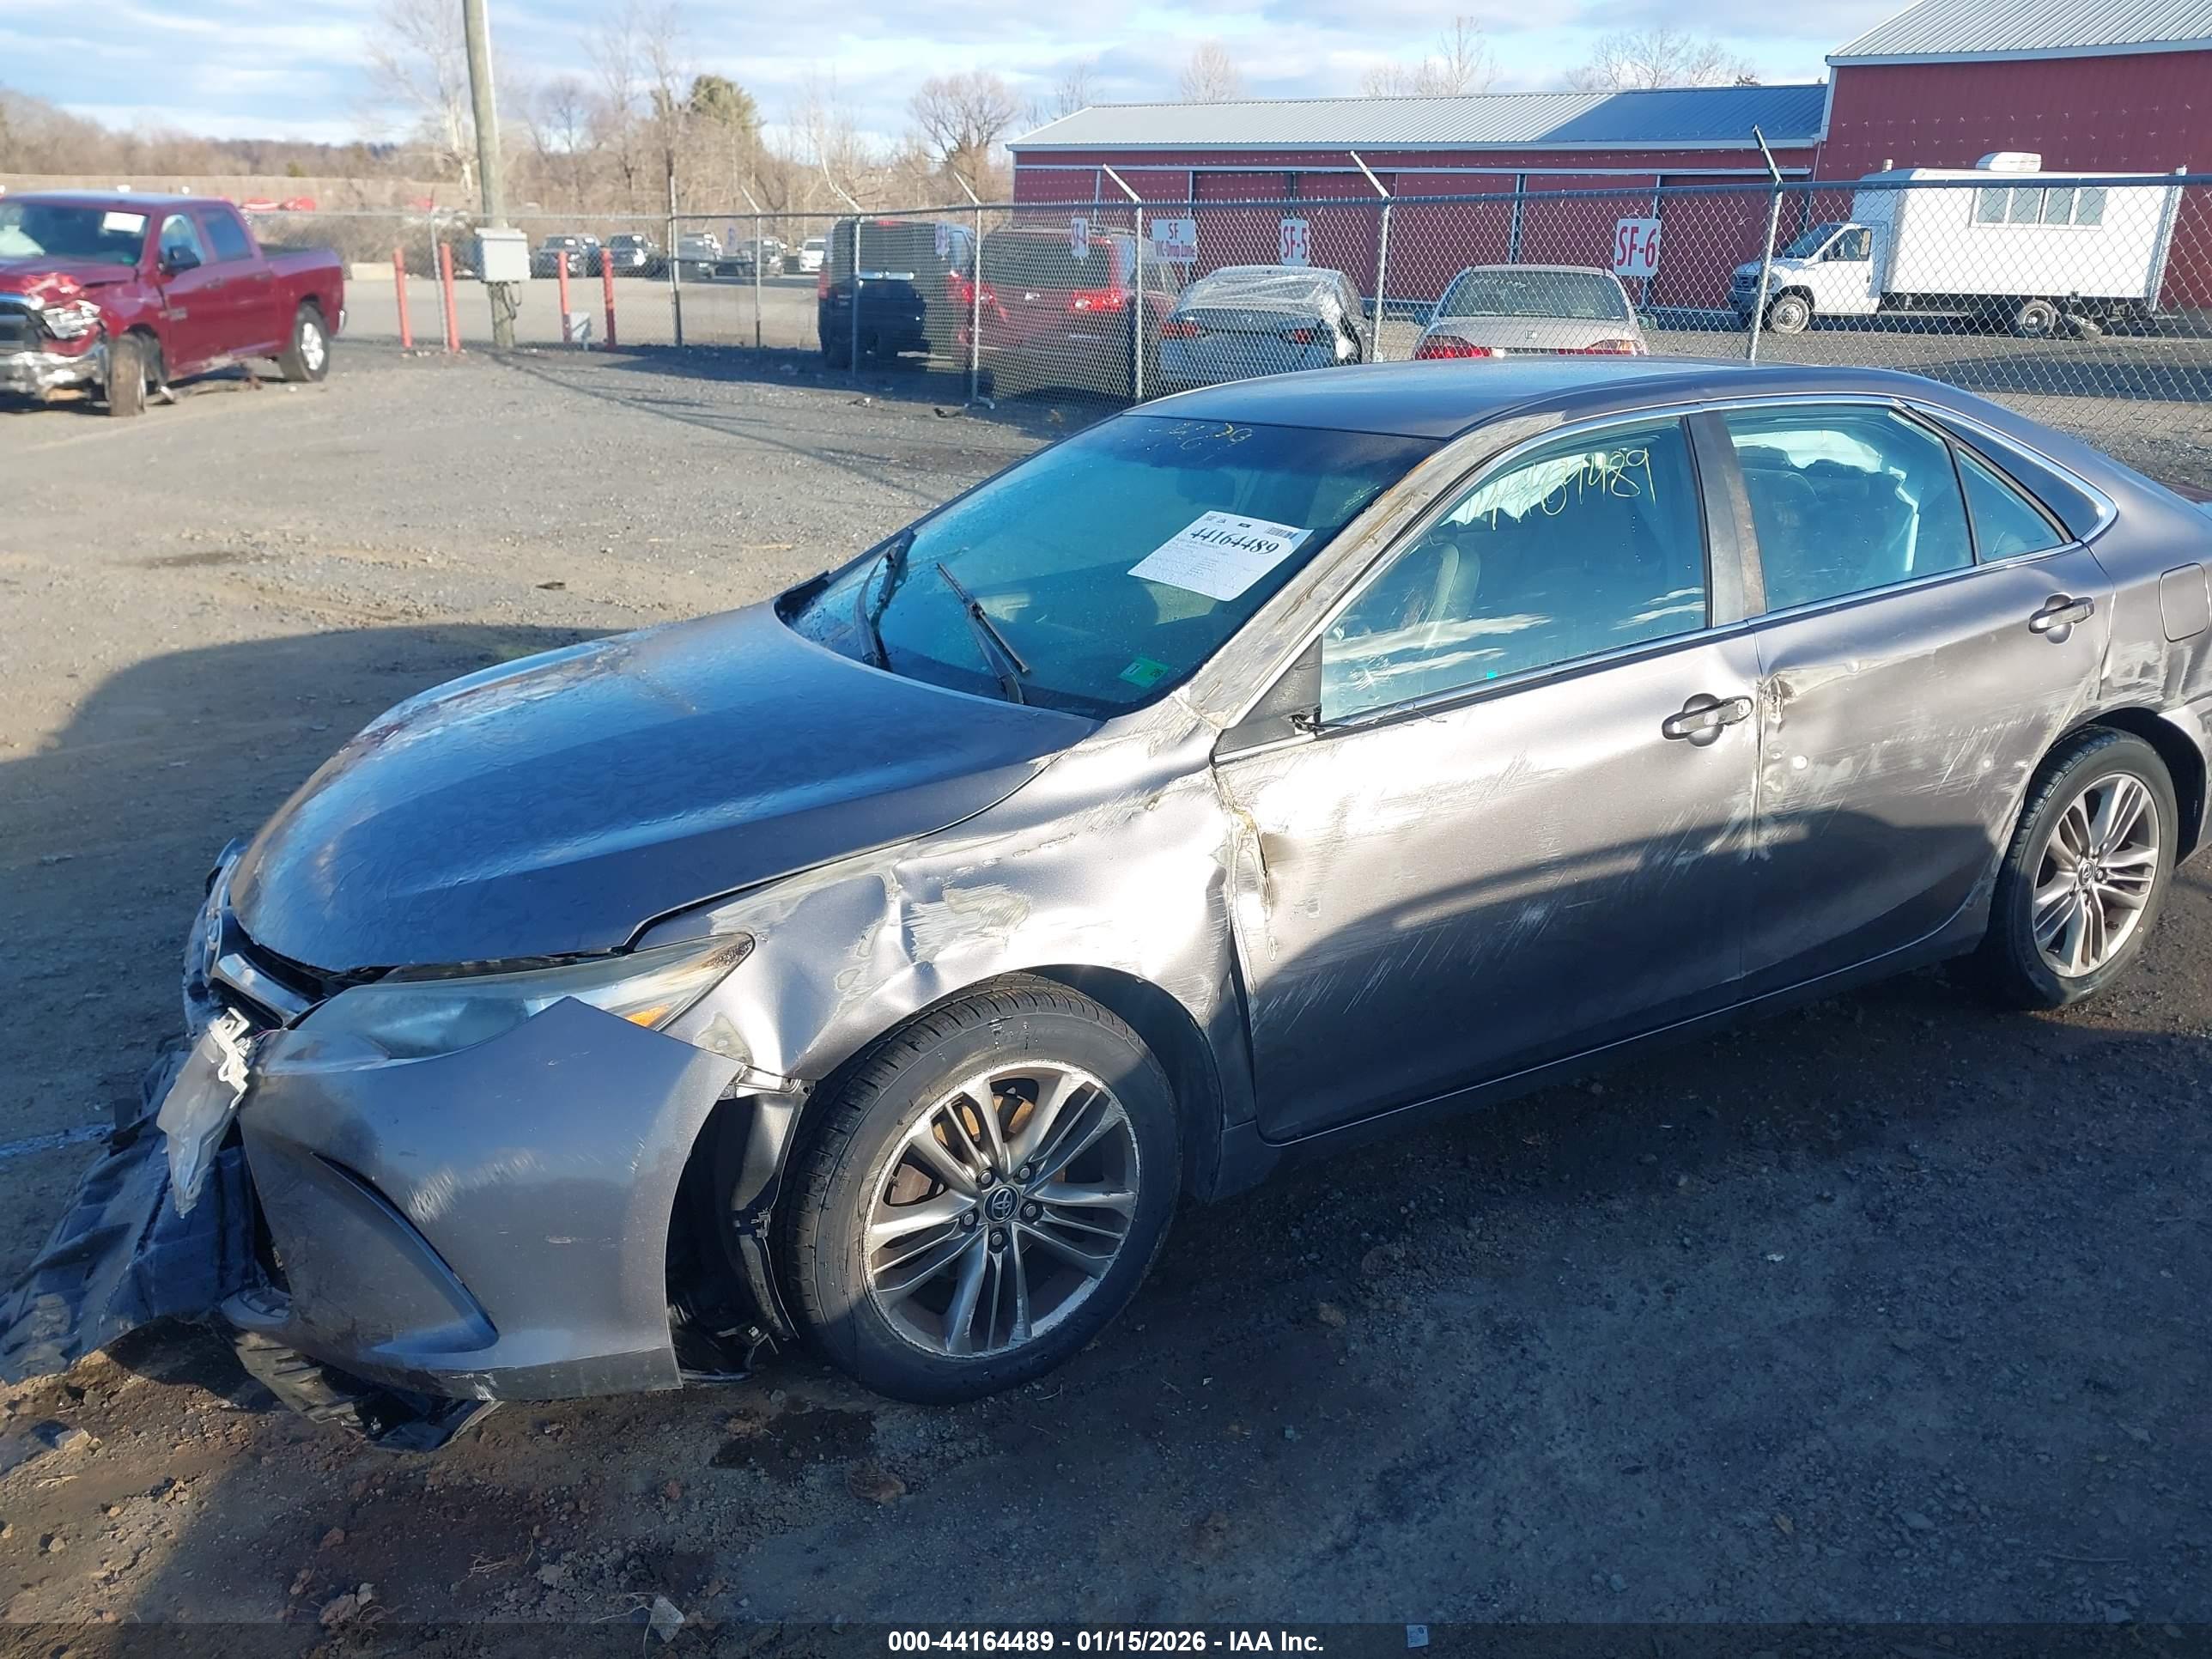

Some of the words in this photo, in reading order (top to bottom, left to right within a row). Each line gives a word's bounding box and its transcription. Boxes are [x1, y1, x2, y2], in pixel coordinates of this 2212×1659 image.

[1169, 222, 1179, 240] SF
[1284, 225, 1307, 259] SF-5
[1617, 226, 1656, 268] SF-6
[1190, 527, 1279, 555] 44164489
